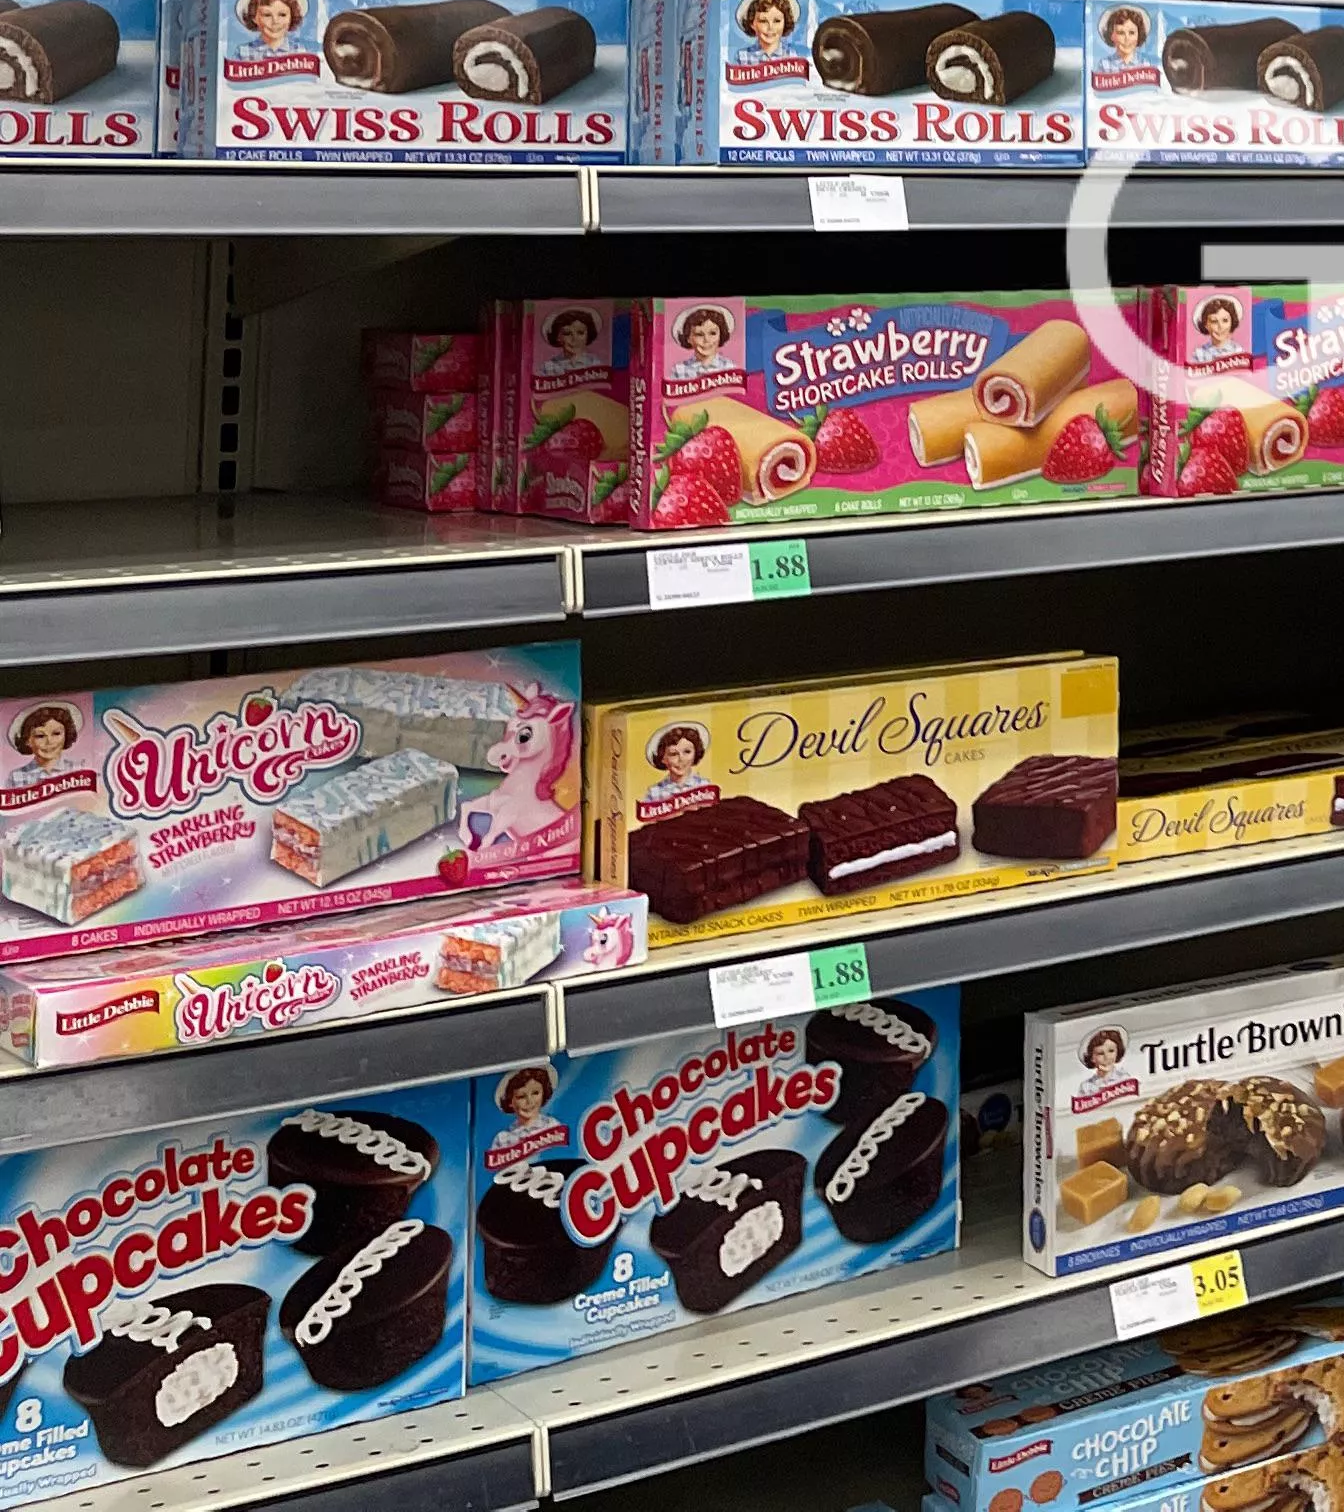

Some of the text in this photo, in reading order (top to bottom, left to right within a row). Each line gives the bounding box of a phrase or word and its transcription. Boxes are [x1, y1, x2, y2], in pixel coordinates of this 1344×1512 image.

[227, 56, 315, 80] Little Debbie
[729, 59, 806, 82] Little Debbie
[230, 97, 616, 147] SWISS ROLLS
[733, 98, 1072, 146] SWISS ROLLS
[728, 150, 795, 162] 12 CAKE ROLLS
[807, 150, 875, 162] TWIN WRAPPED
[886, 150, 918, 162] NET WT
[773, 317, 990, 386] Strawberry
[665, 373, 743, 399] Little Debbie
[774, 360, 963, 411] SHORTCAKE ROLLS
[751, 552, 807, 583] 1.88
[729, 692, 1048, 774] Devil Squares
[944, 748, 985, 765] CAKES
[150, 804, 245, 848] SPARKLING
[1126, 796, 1305, 846] Devil Squares
[150, 819, 256, 869] STRAWBERRY
[71, 907, 261, 946] 8 CAKES INDIVIDUALLY WRAPPED
[350, 963, 429, 1002] STRAWBERRY
[351, 953, 423, 986] SPARKLING
[812, 960, 865, 990] 1.88
[1141, 1027, 1234, 1074] Turtle
[582, 1022, 795, 1161] Chocolate
[566, 1066, 839, 1239] Cupcakes
[612, 1252, 633, 1283] 8
[1194, 1266, 1239, 1297] 3.05
[573, 1272, 670, 1311] Creme Filled
[16, 1398, 42, 1431] 8
[36, 1418, 89, 1447] Filled
[1072, 1399, 1192, 1461] CHOCOLATE
[1096, 1438, 1158, 1478] CHIP
